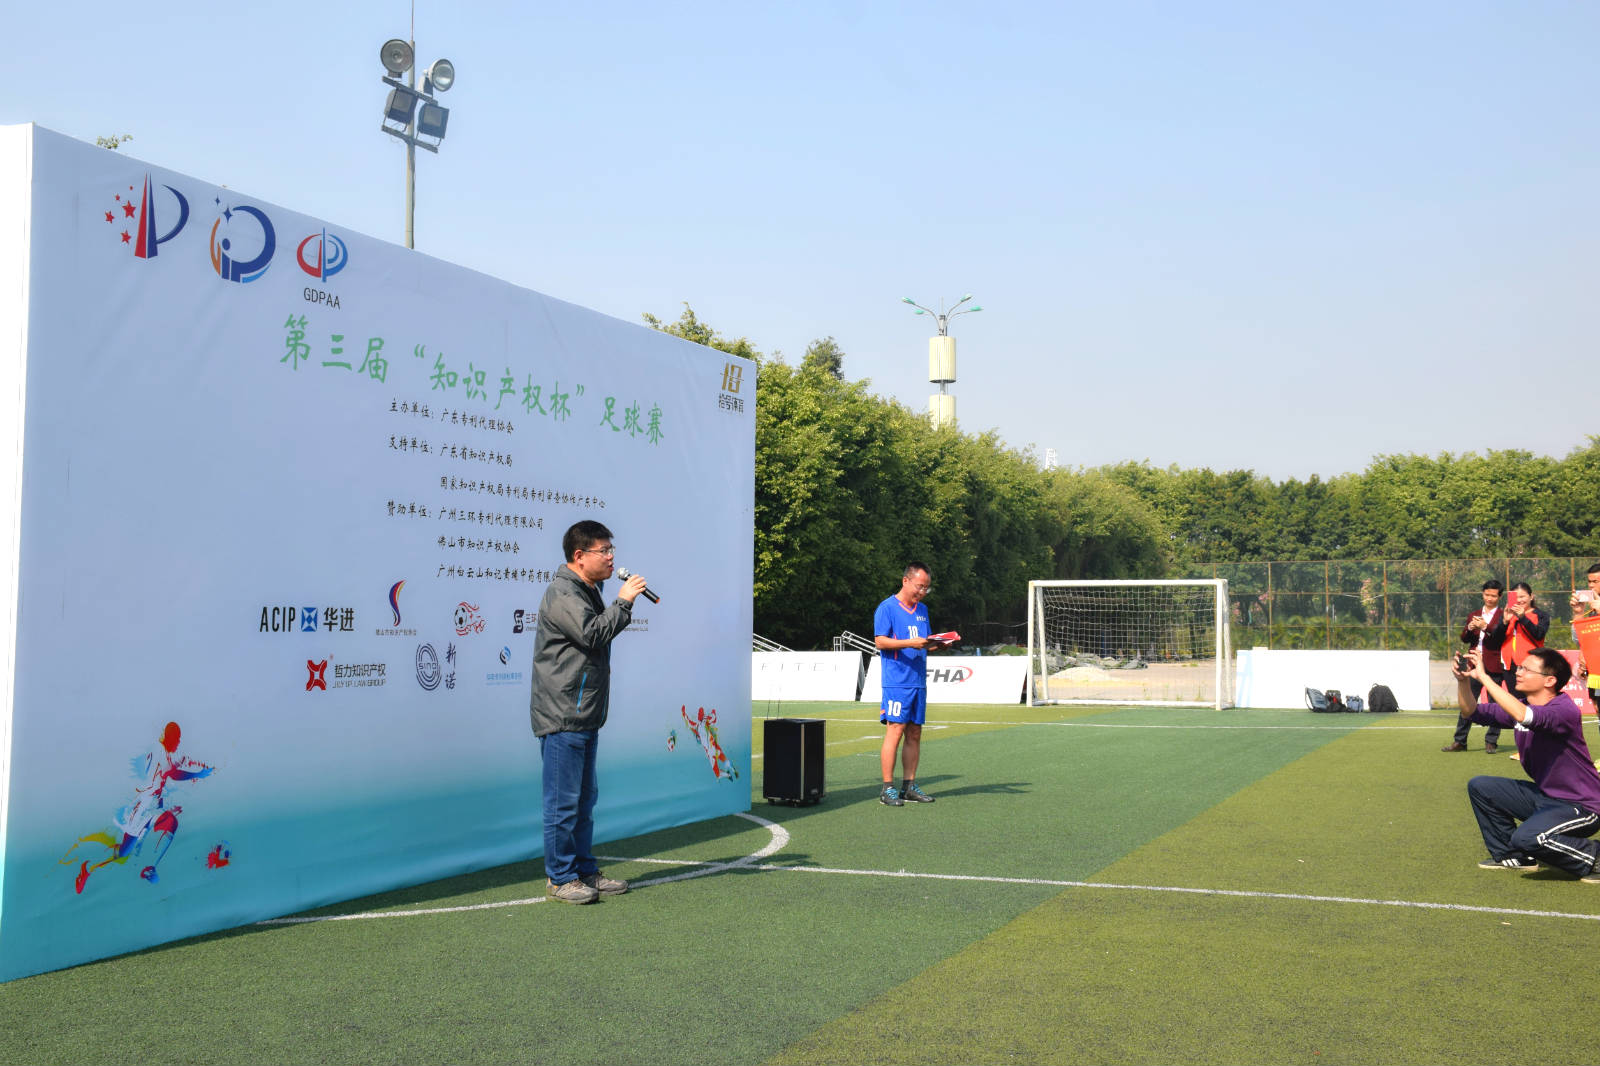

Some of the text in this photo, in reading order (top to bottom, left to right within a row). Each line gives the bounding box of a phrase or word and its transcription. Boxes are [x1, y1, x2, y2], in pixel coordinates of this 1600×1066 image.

[304, 287, 341, 310] GDPAA
[437, 535, 520, 554] 佛山市知识产权协会
[259, 606, 355, 632] ACIP 华进
[907, 625, 919, 639] 10
[334, 664, 386, 678] 哲力知识产权
[445, 641, 457, 690] 新诺
[887, 700, 902, 717] 10
